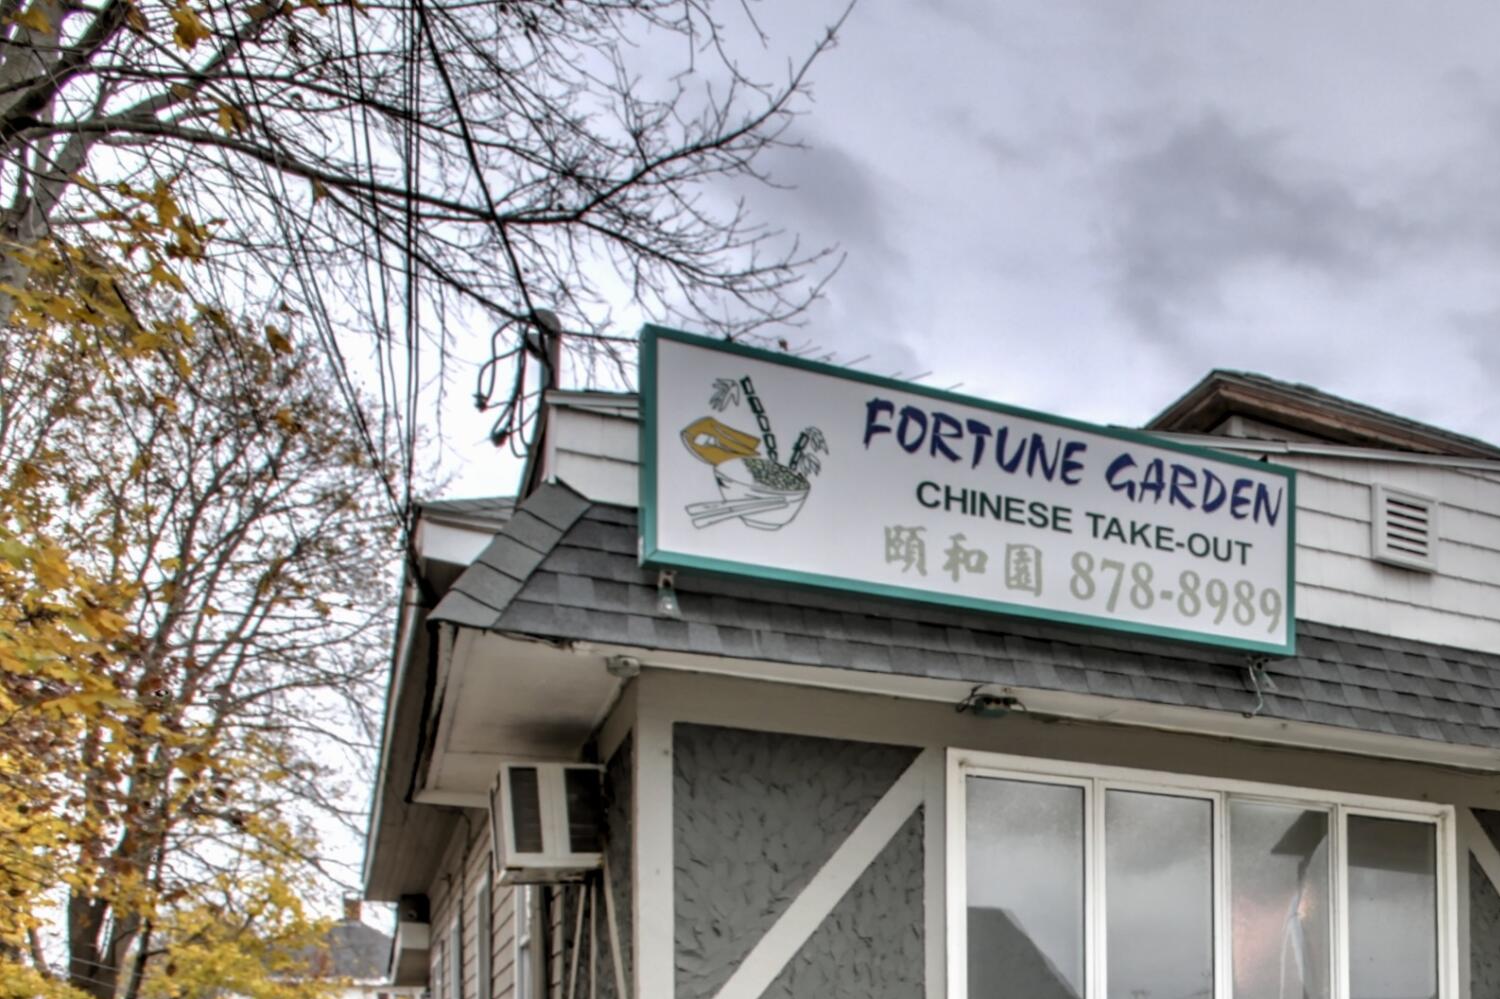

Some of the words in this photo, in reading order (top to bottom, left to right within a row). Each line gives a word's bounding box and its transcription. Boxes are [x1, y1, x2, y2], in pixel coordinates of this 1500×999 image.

[863, 398, 1087, 486] FORTUNE
[1105, 453, 1283, 527] GARDEN
[916, 481, 1072, 534] CHINESE
[1085, 512, 1253, 565] TAKE-OUT
[884, 525, 1042, 597] 頤和園
[1070, 551, 1282, 634] 878-8989
